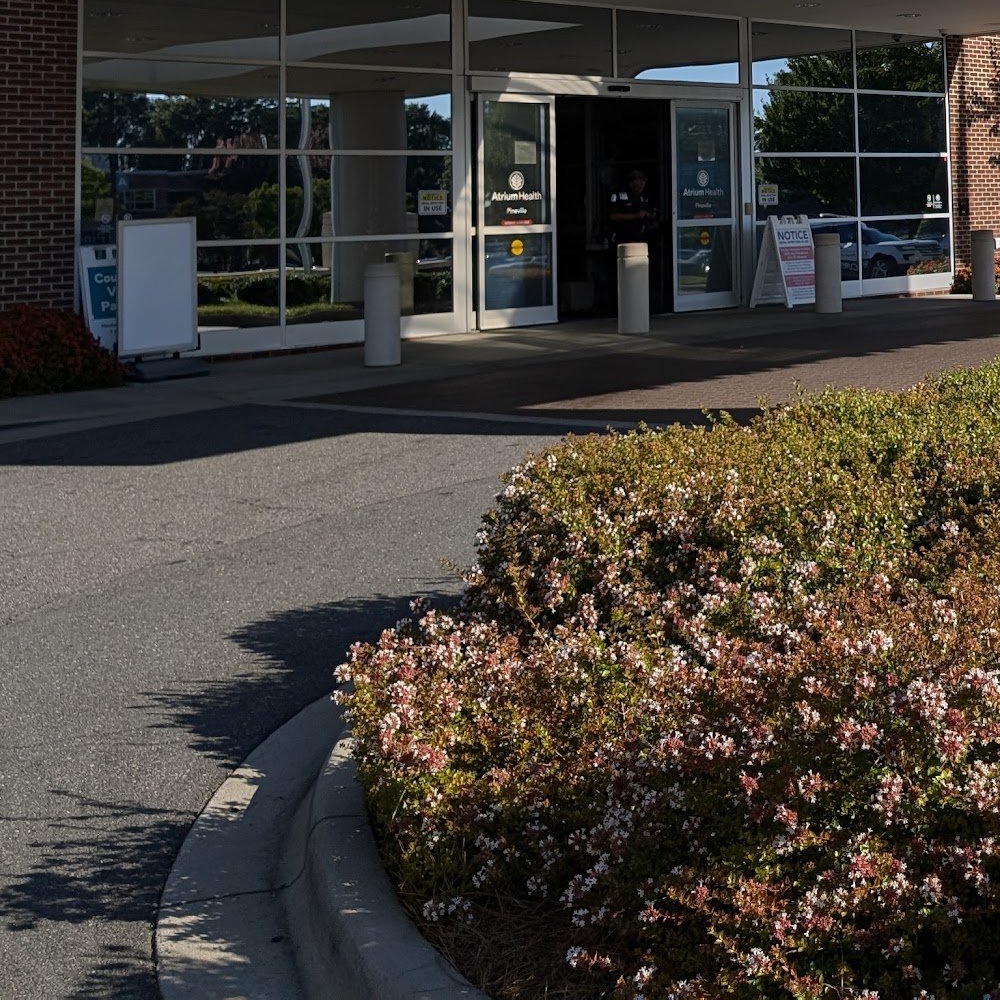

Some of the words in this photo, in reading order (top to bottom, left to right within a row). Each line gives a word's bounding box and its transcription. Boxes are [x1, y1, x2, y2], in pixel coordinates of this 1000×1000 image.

[492, 191, 518, 201] Atrium
[519, 191, 542, 200] Health
[683, 188, 704, 196] Atrium
[705, 188, 724, 196] Health
[777, 230, 809, 241] NOTICE
